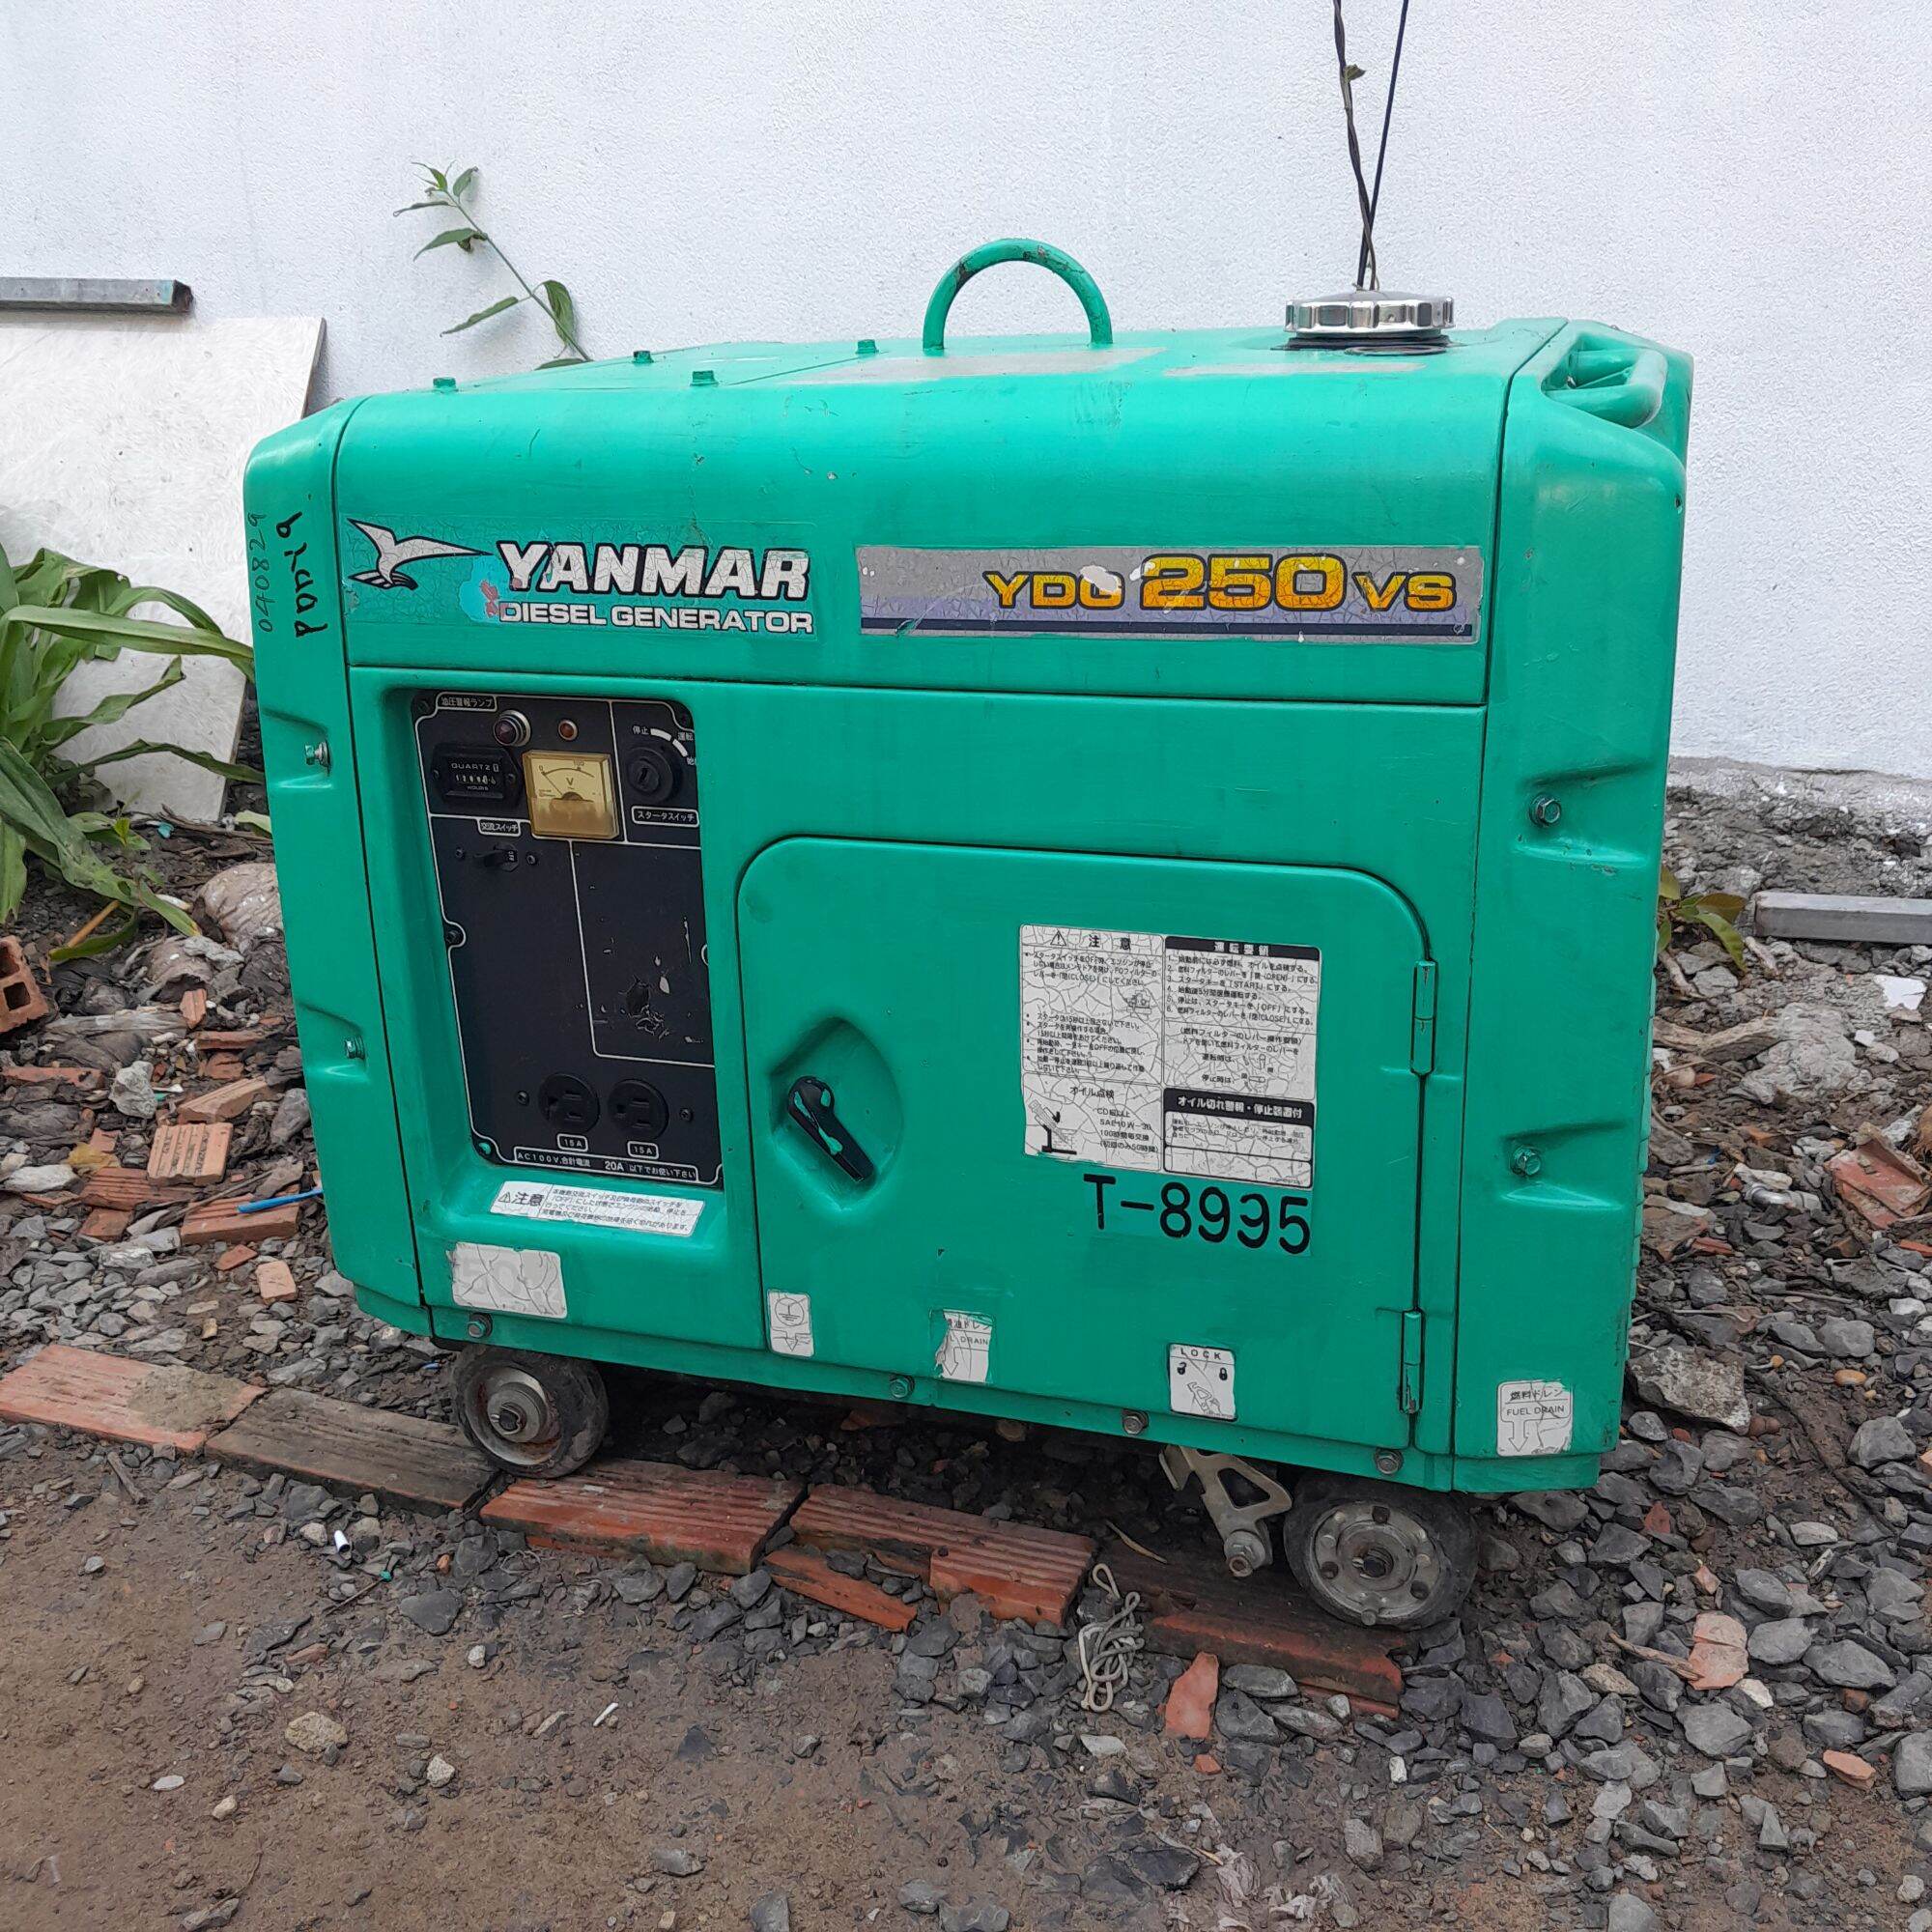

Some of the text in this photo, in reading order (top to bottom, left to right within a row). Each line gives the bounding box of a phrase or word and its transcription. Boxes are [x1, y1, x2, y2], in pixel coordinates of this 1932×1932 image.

[248, 512, 275, 633] 040829
[496, 541, 810, 600] YANMAR
[1139, 553, 1348, 611] 250
[1353, 571, 1457, 611] VS
[498, 600, 813, 634] DIESEL GENERATOR
[632, 724, 649, 735] 停止
[451, 762, 491, 771] QUARTZ
[638, 810, 695, 822] スタータスイッチ
[564, 1138, 582, 1148] 15A
[634, 1146, 653, 1155] 15A
[604, 1160, 624, 1172] 20A
[512, 1191, 545, 1208] 注意
[1083, 1173, 1311, 1255] T-8995
[960, 1336, 988, 1346] DRAIN
[1180, 1347, 1221, 1360] LOCK
[1510, 1388, 1562, 1401] 燃料ドレン
[1507, 1405, 1564, 1416] FUEL DRAIN
